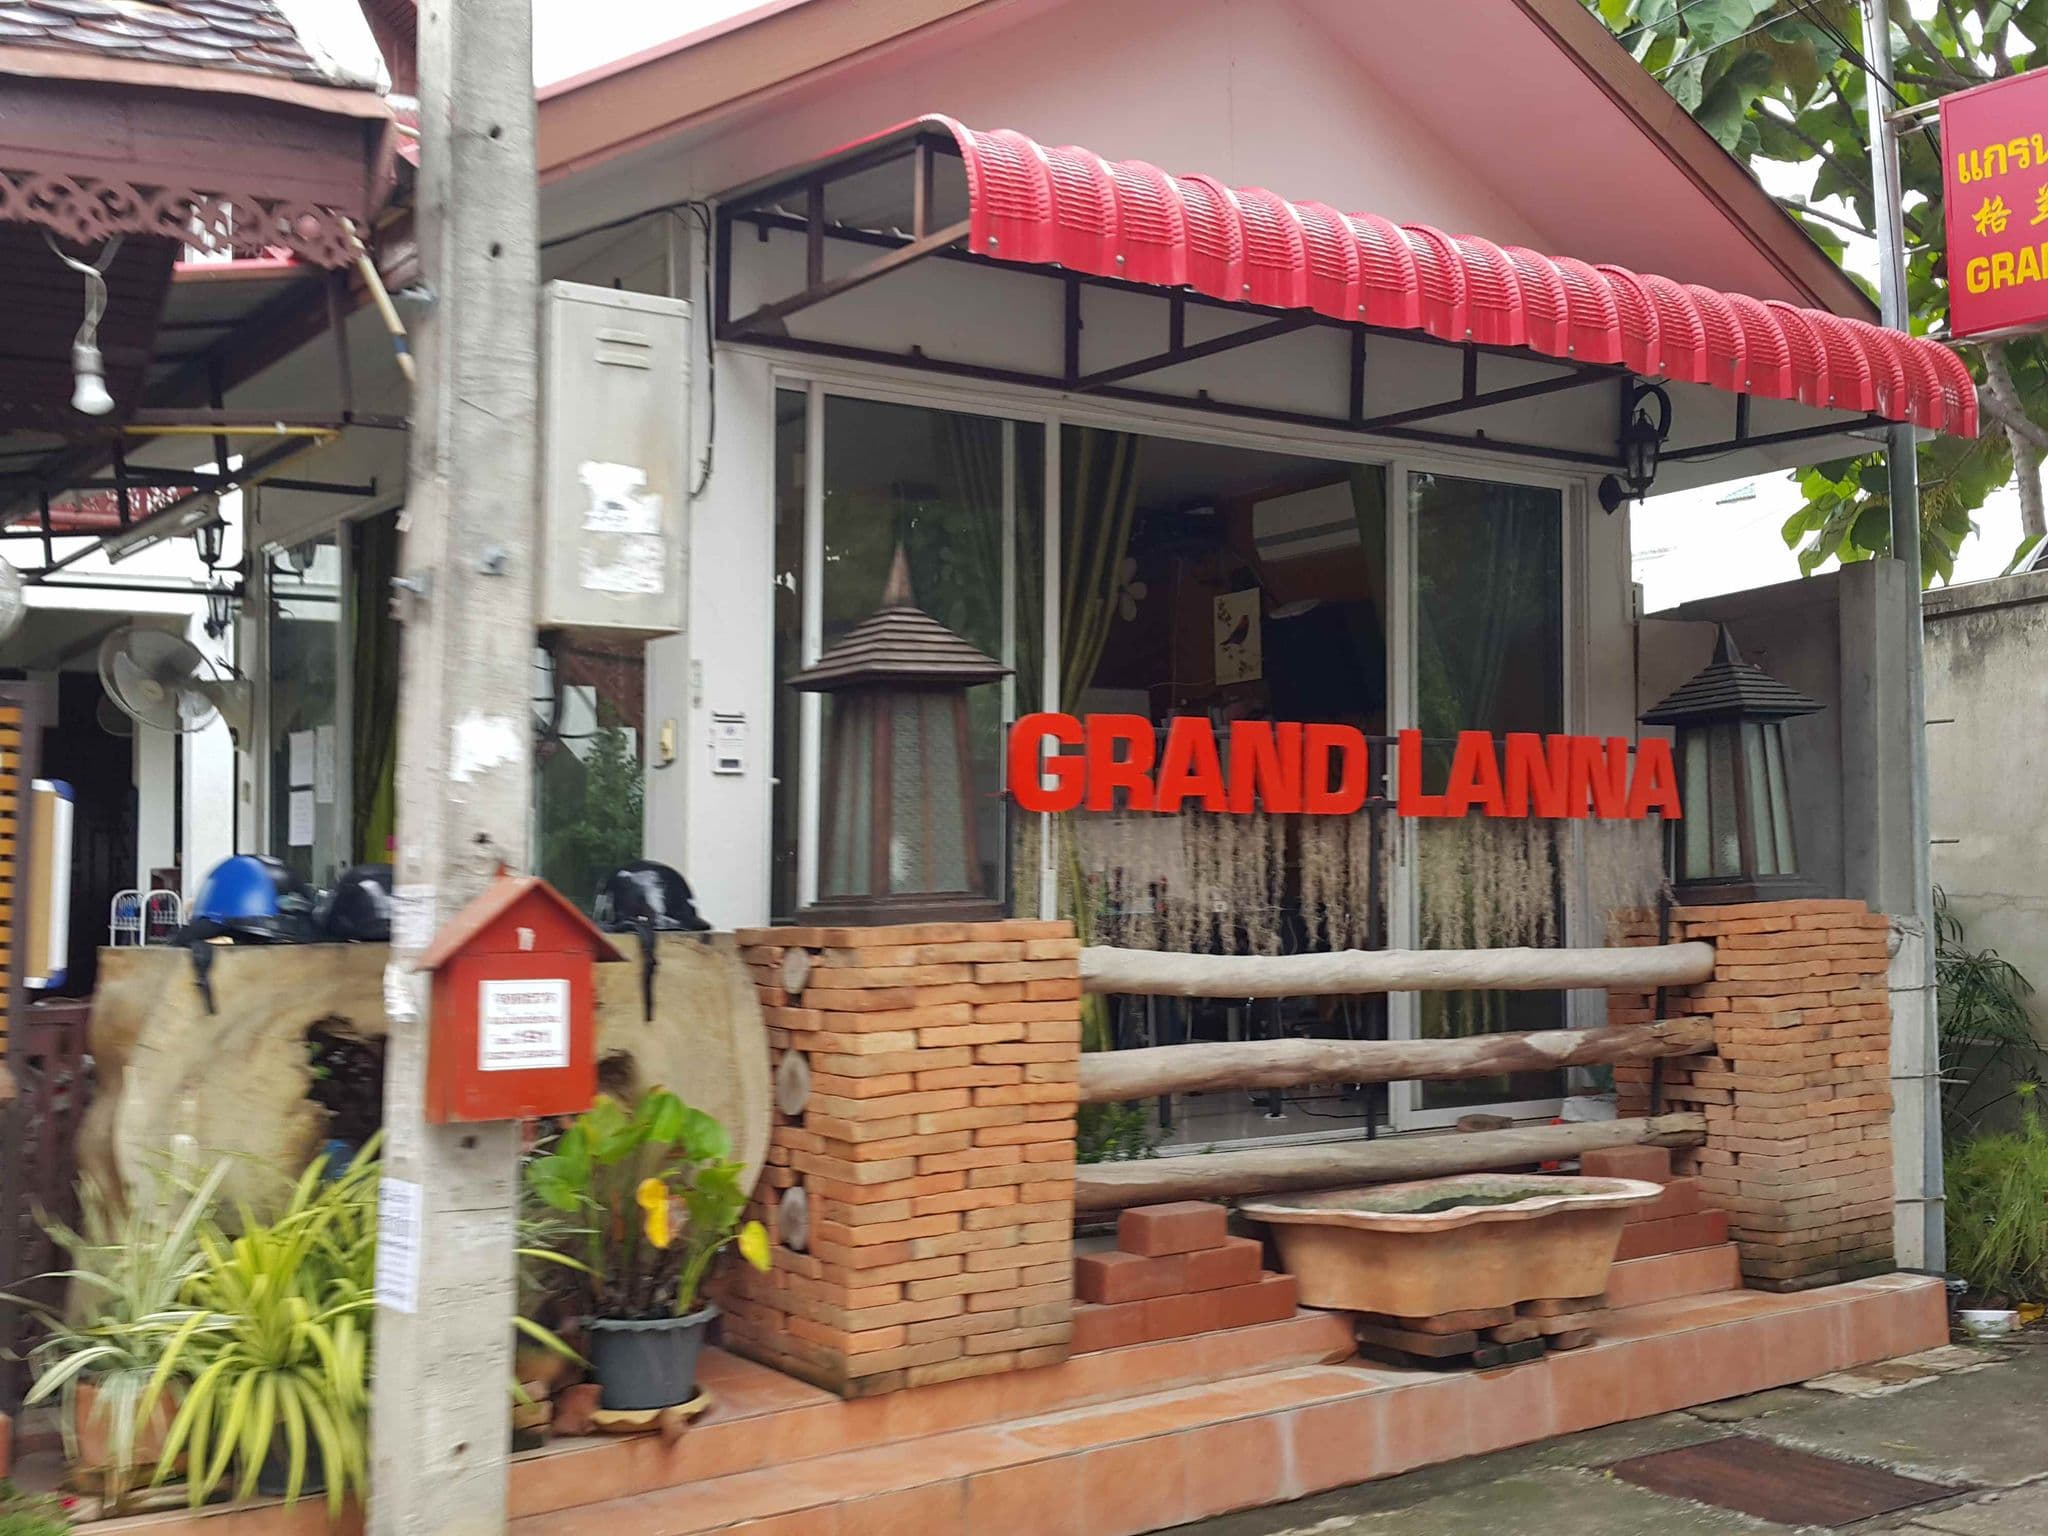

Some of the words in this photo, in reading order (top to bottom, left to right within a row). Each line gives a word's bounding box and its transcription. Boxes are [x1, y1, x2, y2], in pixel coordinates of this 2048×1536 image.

[1966, 242, 2048, 294] GRA
[1007, 712, 1369, 815] GRAND
[1396, 728, 1682, 820] LANNA
